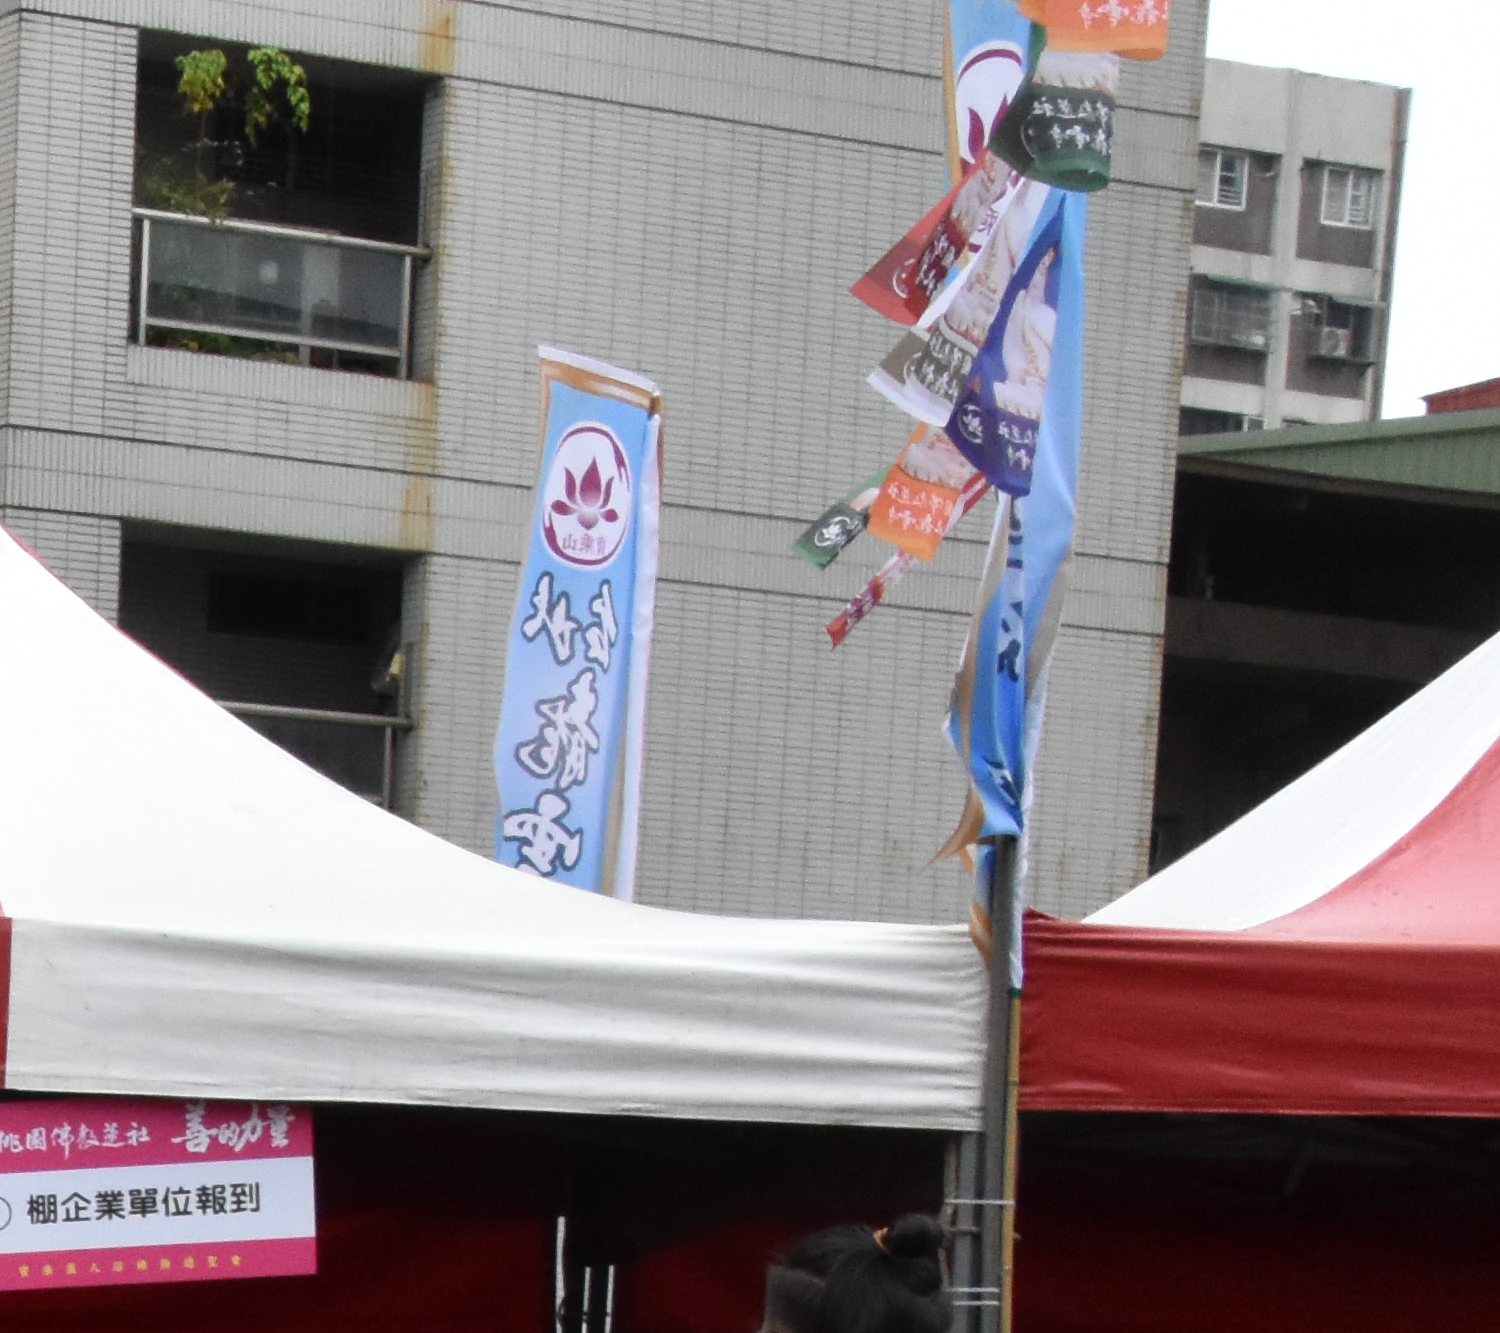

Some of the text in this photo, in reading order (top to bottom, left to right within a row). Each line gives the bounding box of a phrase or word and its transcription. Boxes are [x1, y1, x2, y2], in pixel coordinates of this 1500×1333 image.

[26, 1181, 261, 1225] 棚企業單位報到
